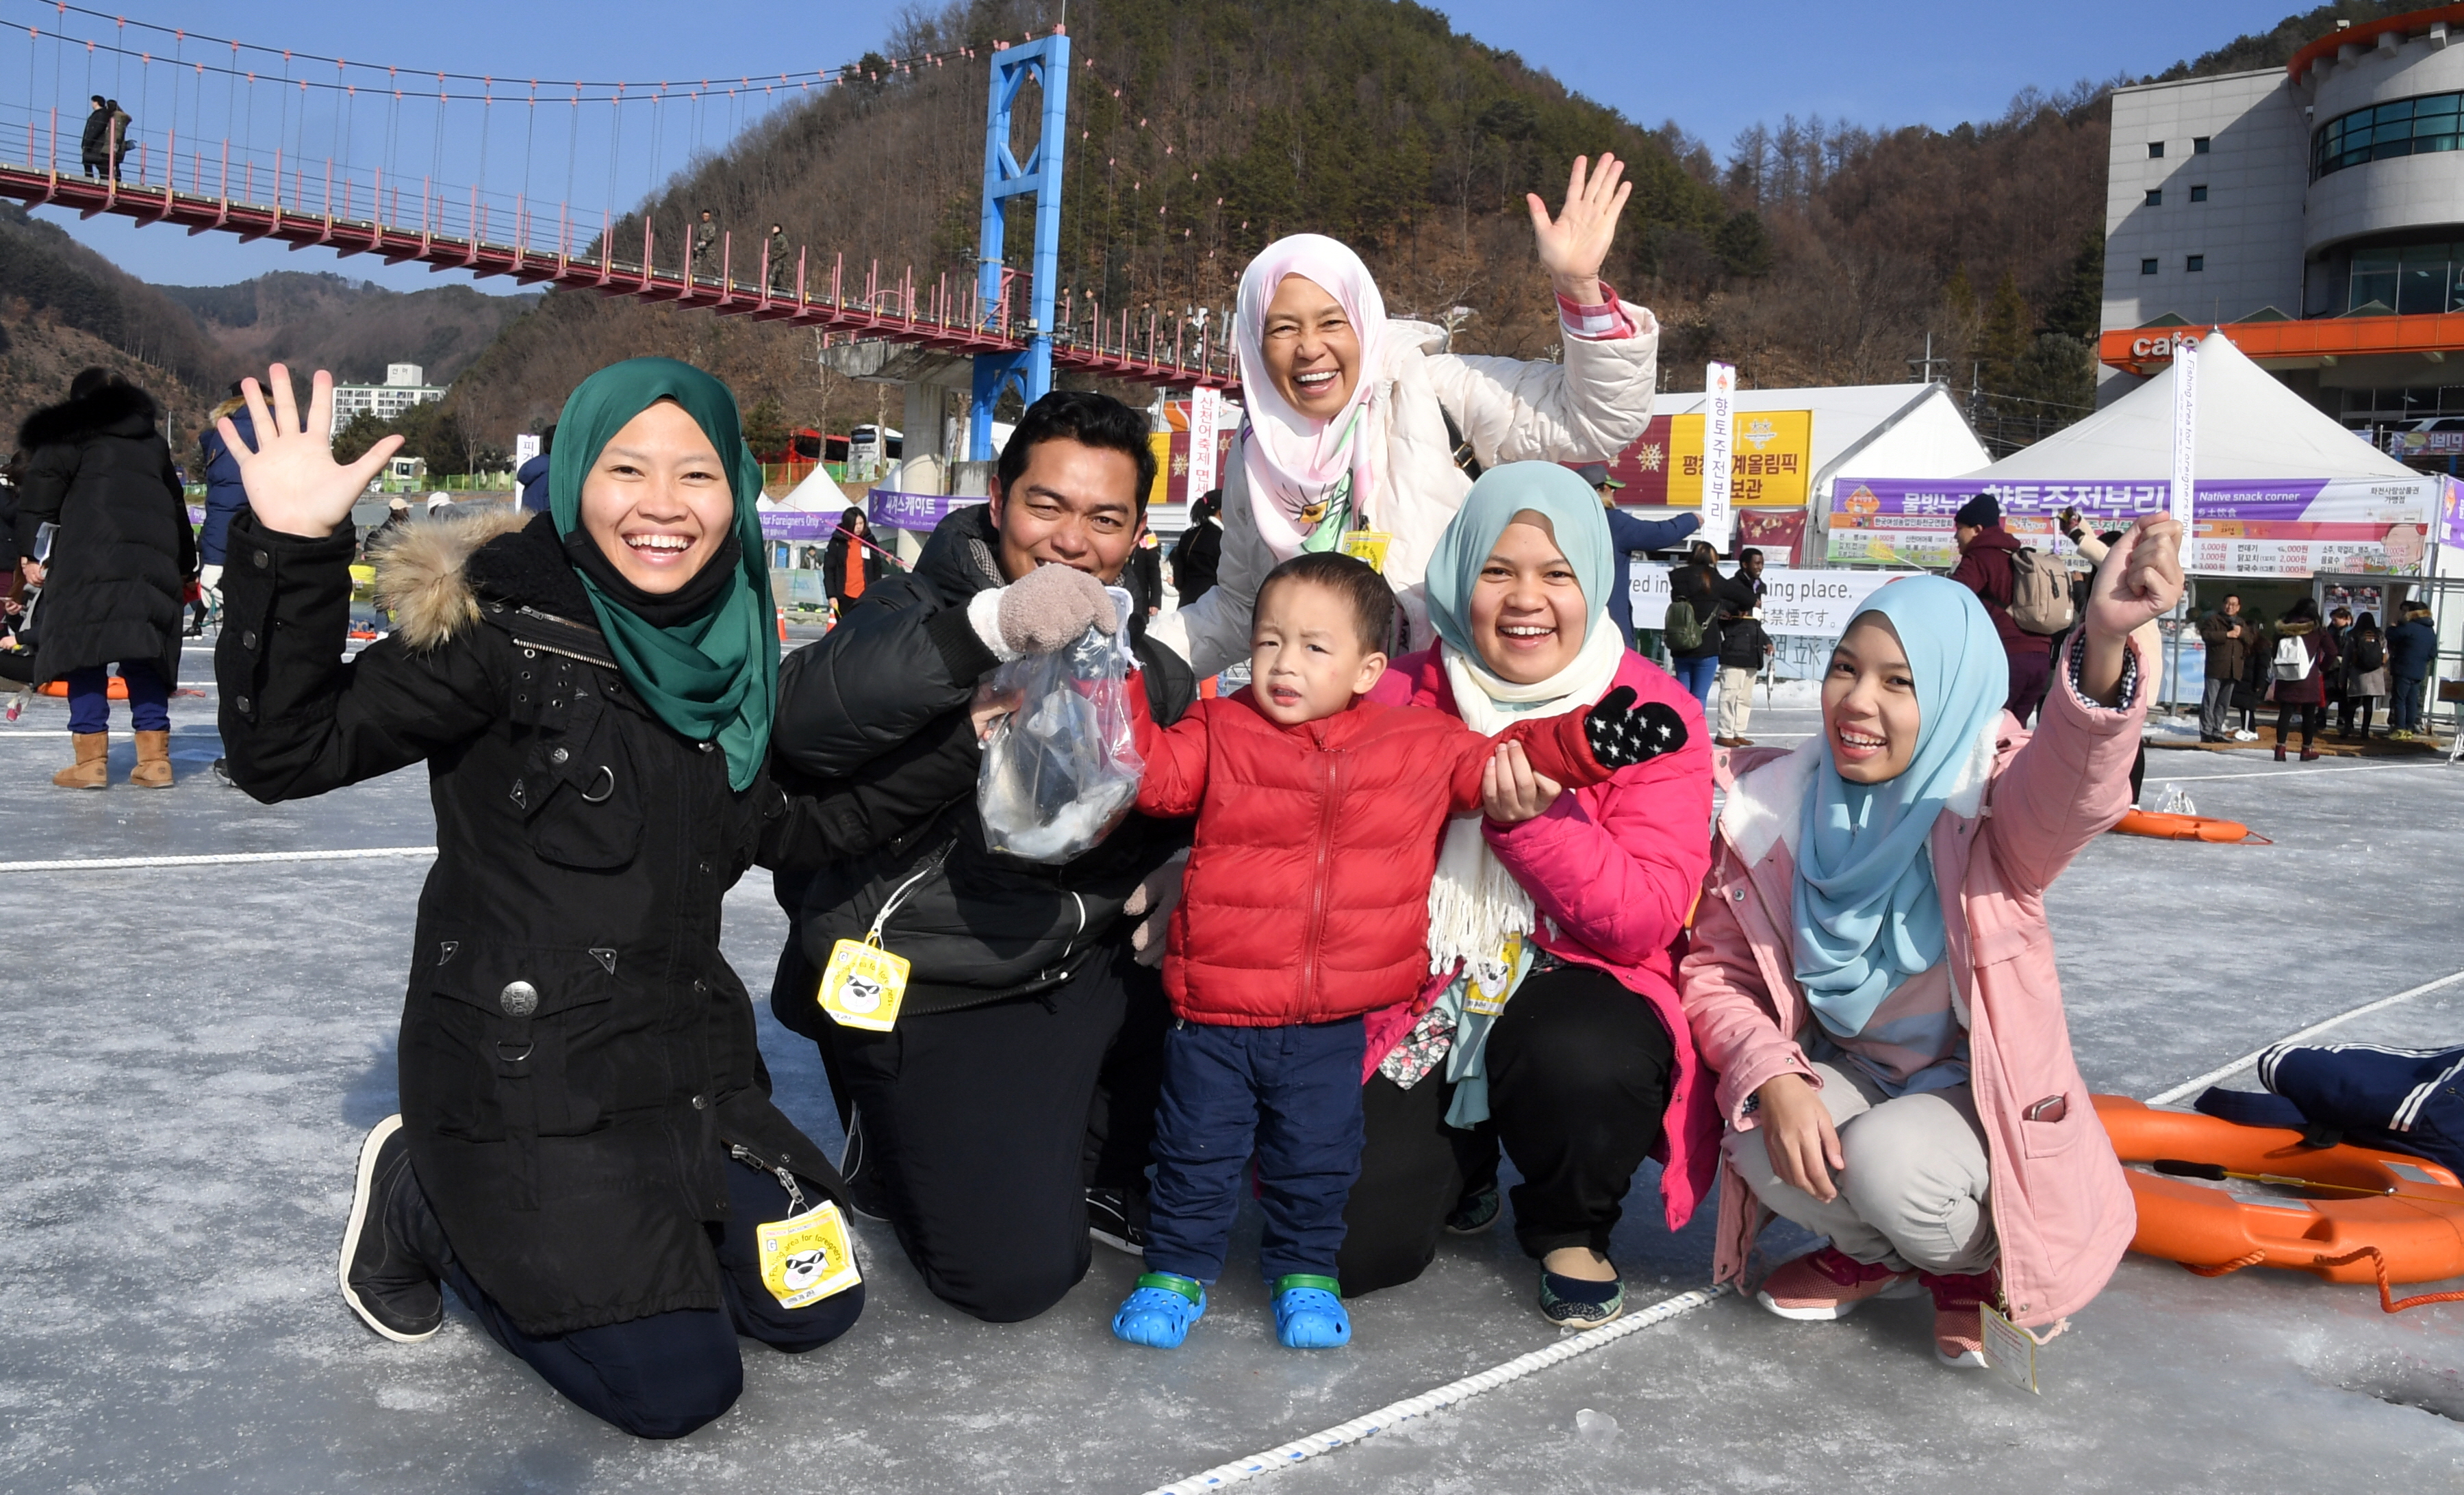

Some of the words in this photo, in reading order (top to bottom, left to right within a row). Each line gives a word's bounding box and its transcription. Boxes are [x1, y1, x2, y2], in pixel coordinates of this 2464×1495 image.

[2133, 331, 2200, 356] cafe
[2184, 359, 2194, 397] Fishing
[2185, 400, 2193, 426] Area
[1197, 397, 1214, 465] 산천어축제
[1683, 453, 1798, 476] 평계올림픽
[1711, 397, 1728, 522] 향토주전부리
[1195, 469, 1210, 498] 면세
[1730, 478, 1763, 500] 보관
[2370, 486, 2420, 496] 화천사랑상품권
[885, 495, 936, 518] 피겨스케이트
[2199, 491, 2231, 502] Native
[2233, 491, 2263, 502] snack
[2265, 493, 2300, 502] corner
[2384, 496, 2406, 504] 가맹점
[763, 515, 771, 525] for
[772, 515, 805, 528] Foreigners
[806, 515, 820, 528] Only
[2198, 508, 2237, 518] 乡土饮食
[2182, 513, 2190, 538] Only
[2200, 543, 2227, 552] 5,000원
[2200, 552, 2226, 561] 3,000원
[2237, 544, 2258, 552] 번데기
[2278, 545, 2309, 554] ,000원
[2237, 554, 2259, 562] 닭꼬치
[2279, 555, 2307, 564] 2,000원
[2237, 564, 2258, 573] 쌀국수
[2278, 565, 2307, 574] 3,000원
[1764, 578, 1794, 602] ing
[1800, 578, 1853, 602] place.
[767, 1239, 776, 1251] G
[784, 1238, 799, 1251] area
[801, 1234, 813, 1242] for
[815, 1234, 841, 1261] foreigners
